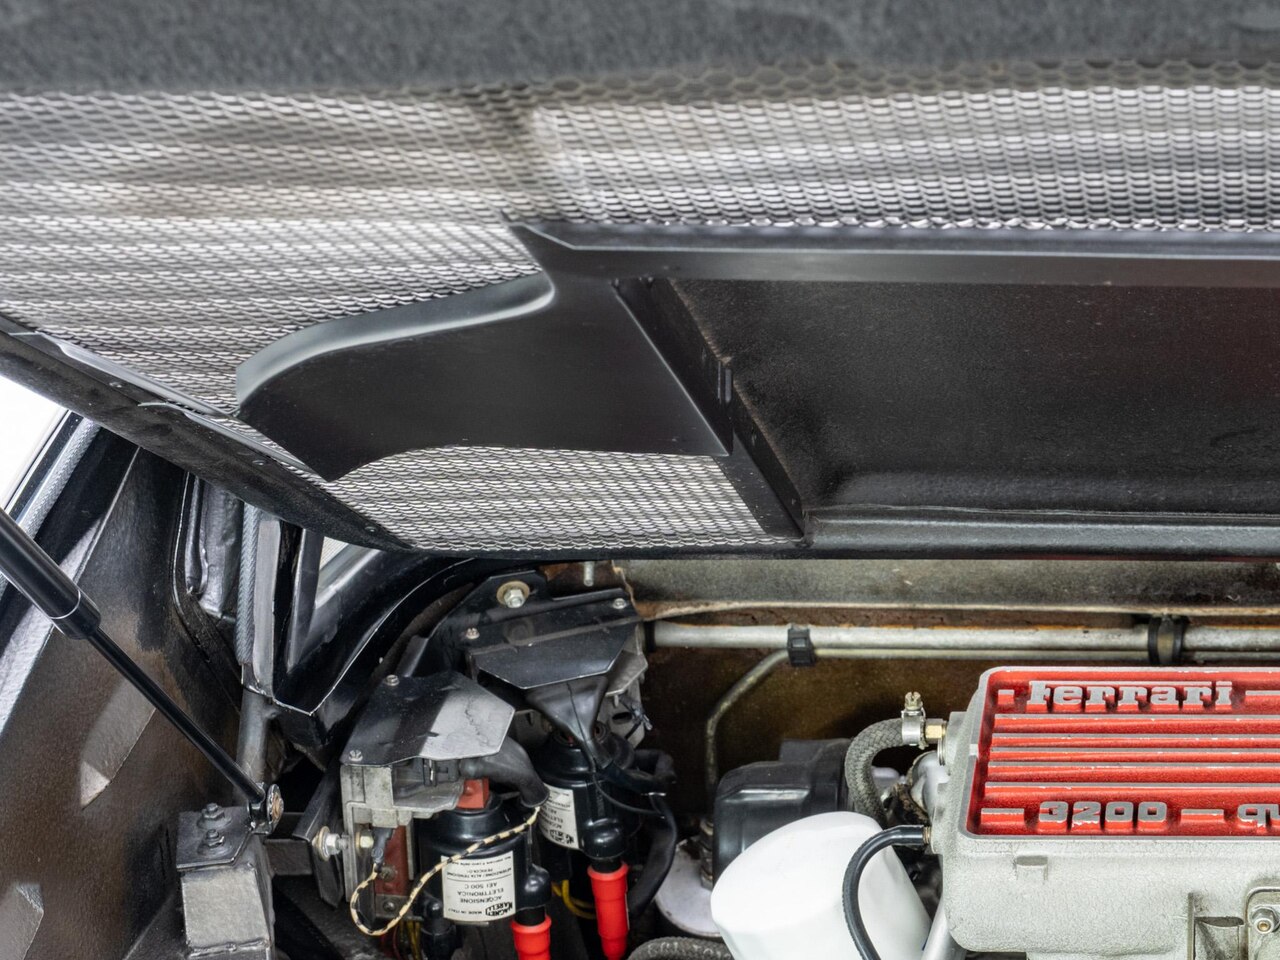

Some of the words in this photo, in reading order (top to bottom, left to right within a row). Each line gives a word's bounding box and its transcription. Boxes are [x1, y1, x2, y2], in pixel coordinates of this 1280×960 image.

[1026, 681, 1233, 706] Ferrari
[1037, 801, 1168, 826] 3200
[457, 887, 503, 897] ELETTRONICA
